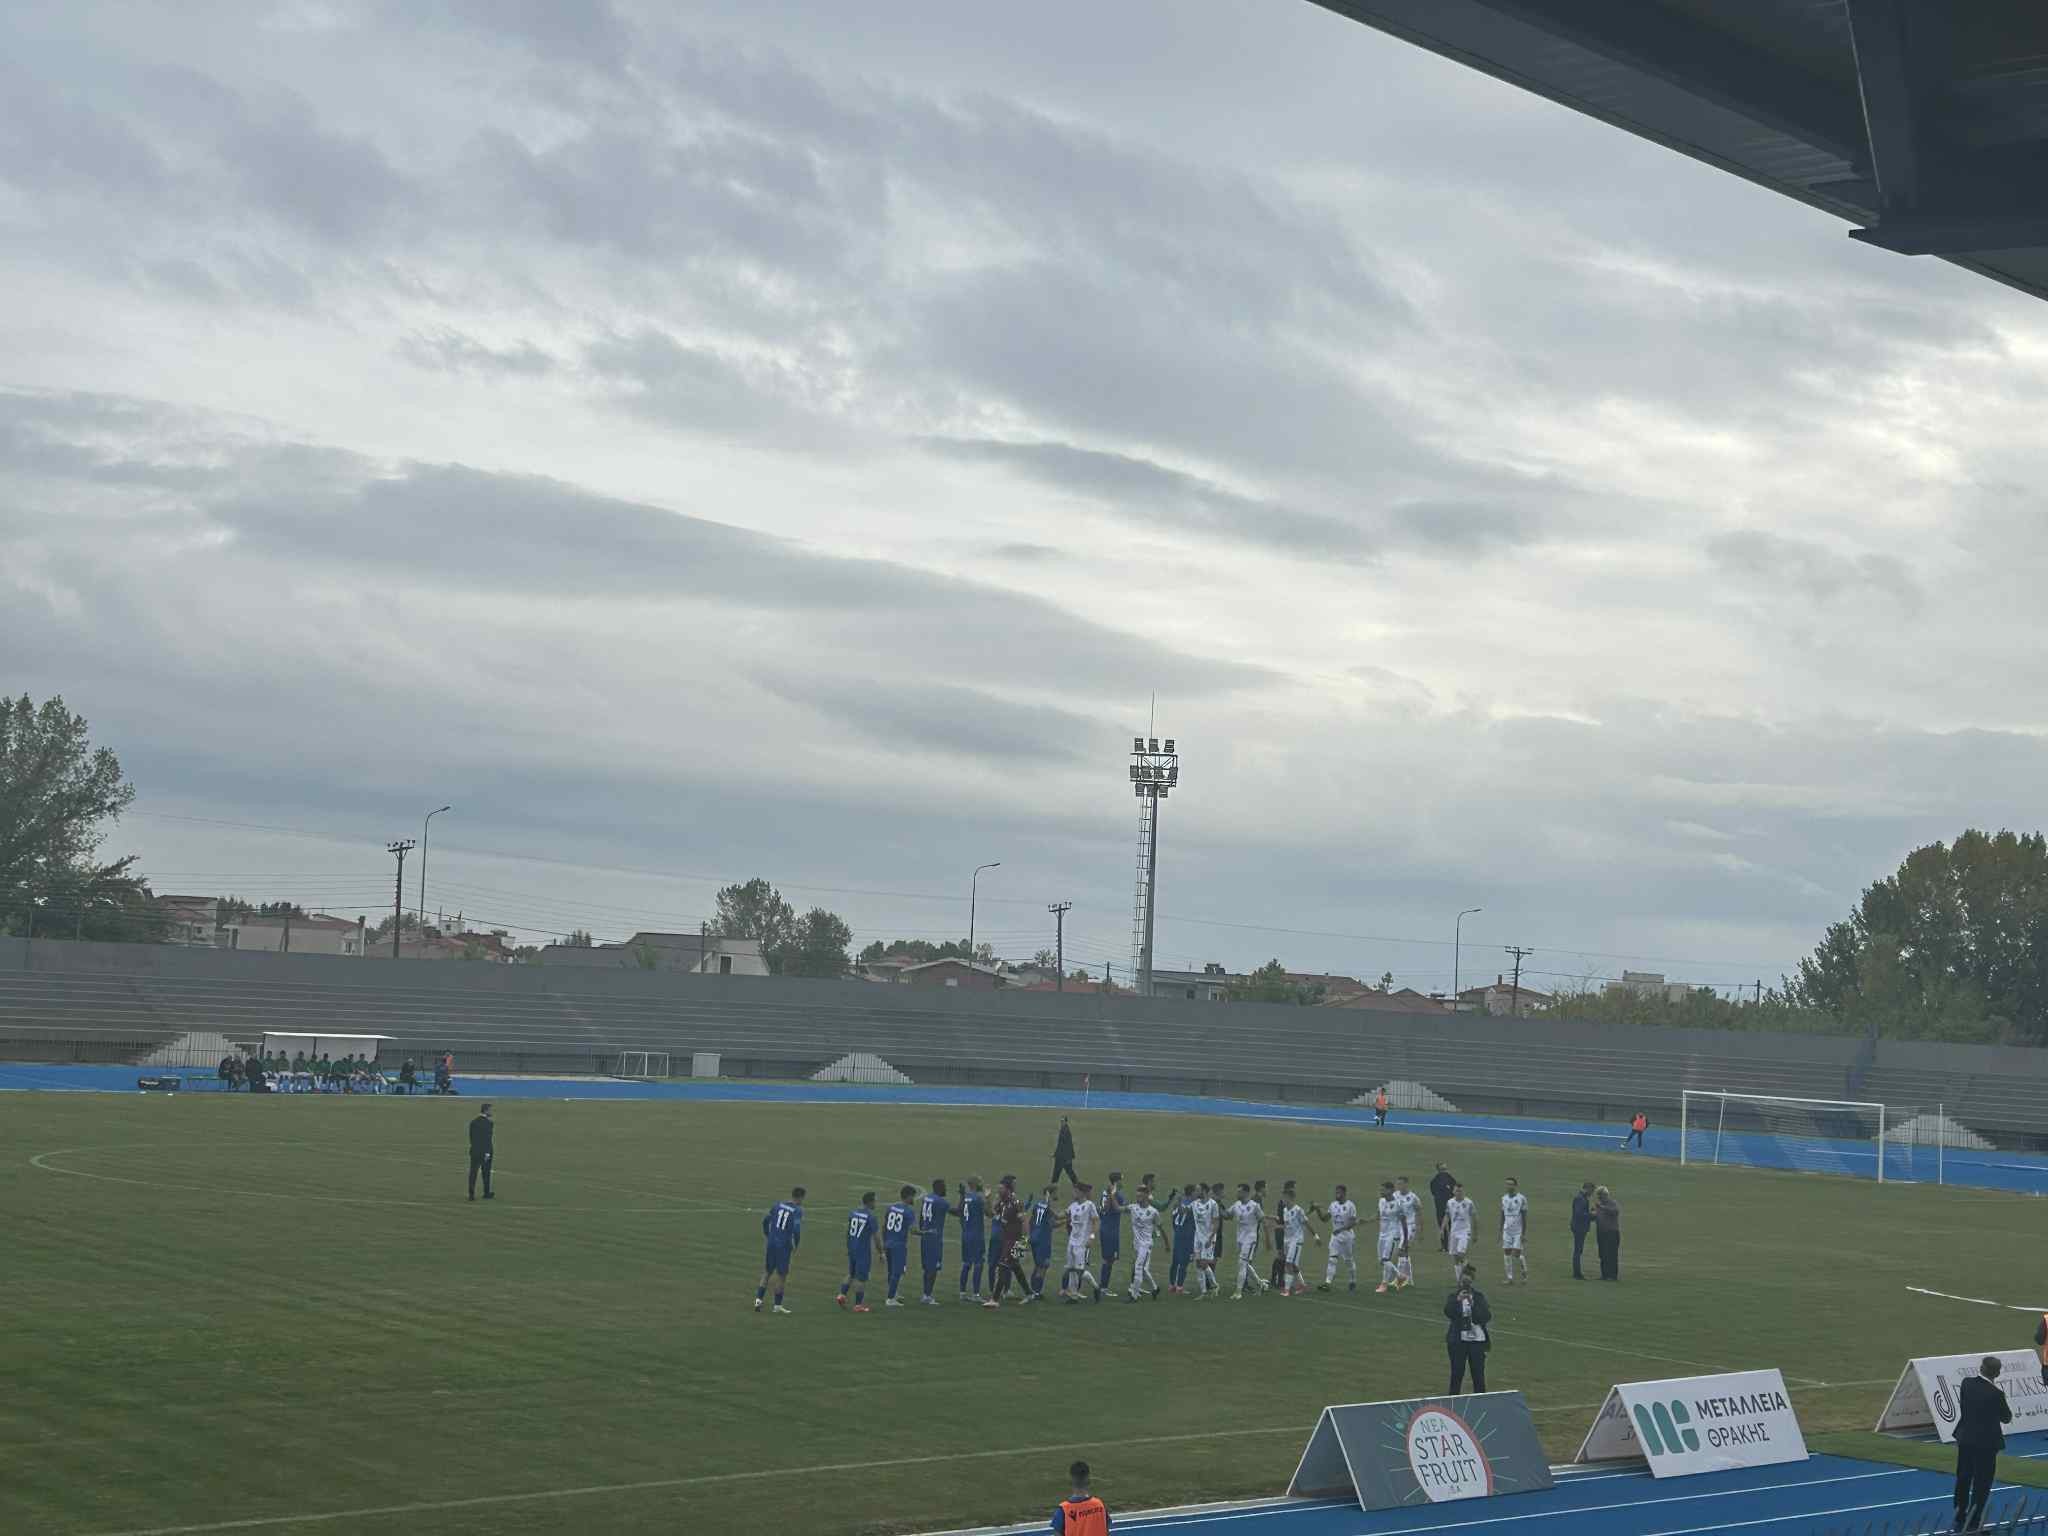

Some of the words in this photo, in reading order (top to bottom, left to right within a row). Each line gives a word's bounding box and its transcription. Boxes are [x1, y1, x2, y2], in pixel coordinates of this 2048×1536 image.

[776, 1210, 790, 1230] 11
[887, 1212, 904, 1232] 83
[1695, 1391, 1787, 1420] ΜΕΤΑΛΛΕΙΑ
[1415, 1434, 1468, 1460] STAR
[1707, 1422, 1770, 1448] ΘΡΑΚΗΣ
[1417, 1459, 1477, 1487] FRUIT
